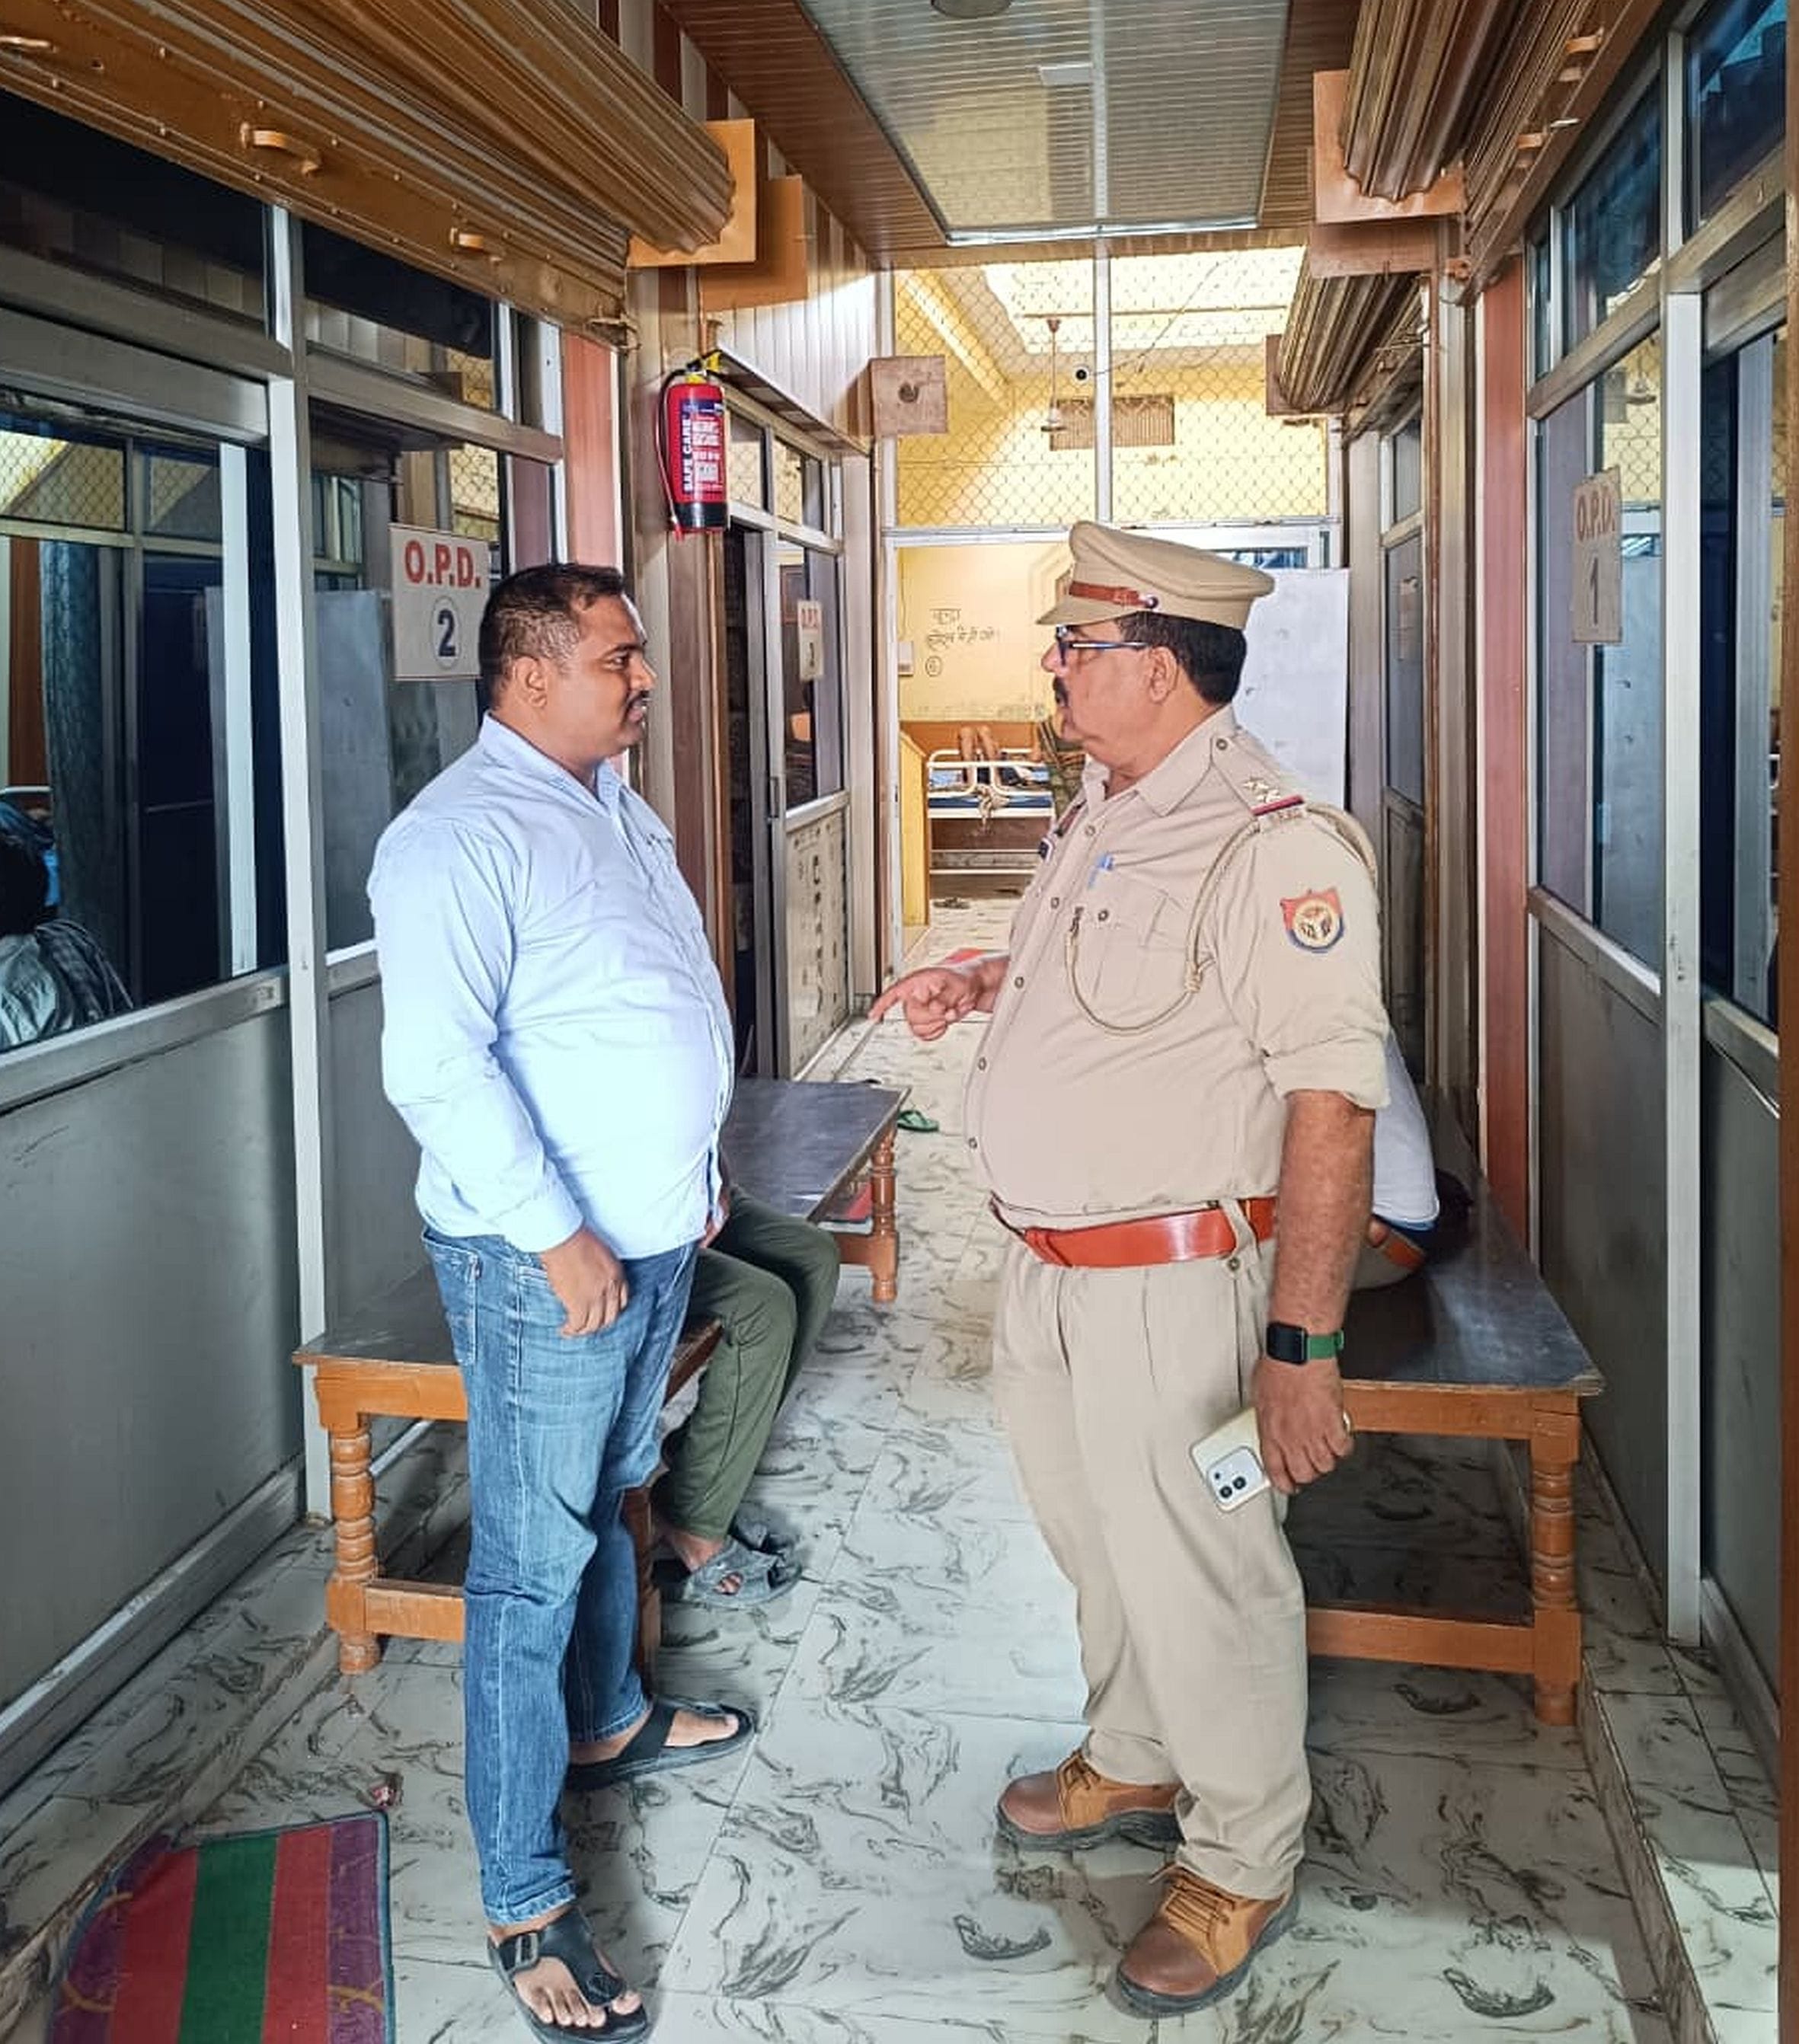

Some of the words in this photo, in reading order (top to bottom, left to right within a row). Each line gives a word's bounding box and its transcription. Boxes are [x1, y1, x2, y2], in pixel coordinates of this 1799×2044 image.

[1577, 485, 1615, 542] O.P.D.
[404, 540, 481, 589] O.P.D.
[1590, 557, 1598, 625] 1
[437, 608, 456, 657] 2
